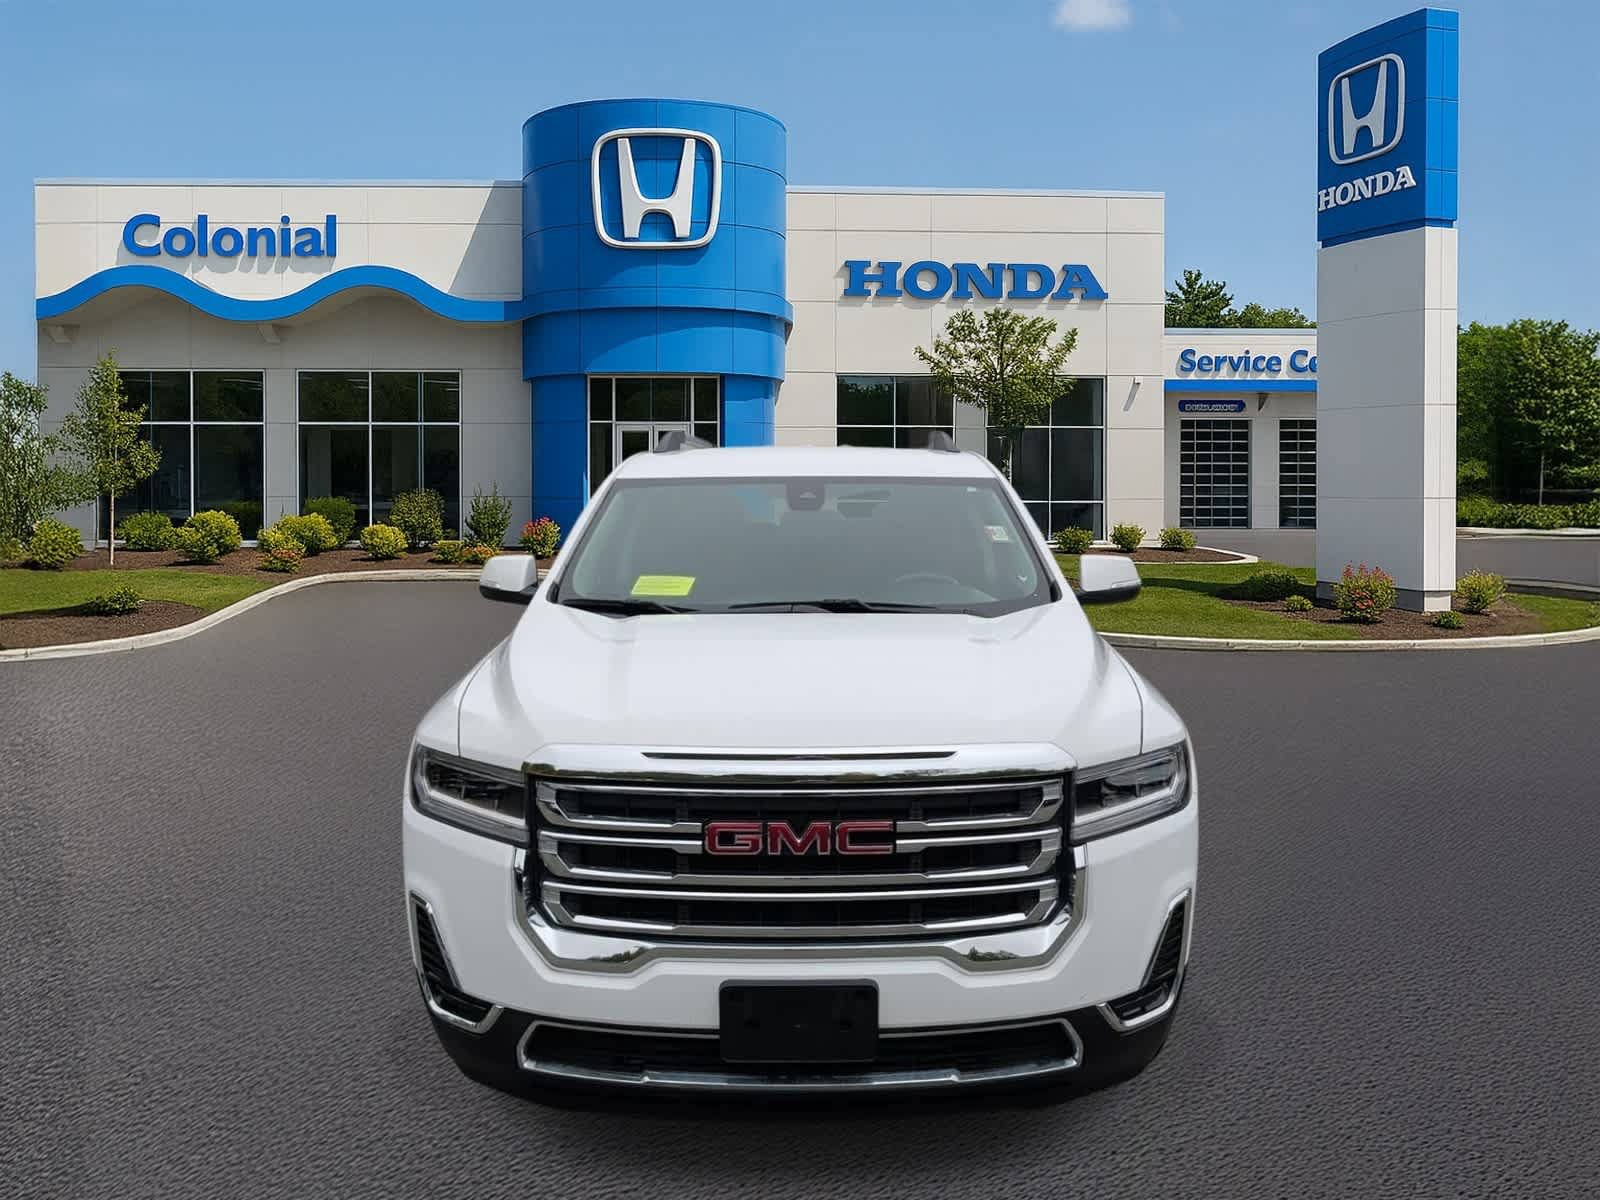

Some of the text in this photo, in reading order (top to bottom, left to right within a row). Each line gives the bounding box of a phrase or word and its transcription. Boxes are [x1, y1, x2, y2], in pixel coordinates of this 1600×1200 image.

[1318, 165, 1417, 212] HONDA
[122, 213, 337, 257] Colonial
[843, 260, 1109, 300] HONDA
[1180, 348, 1282, 373] Service
[704, 821, 894, 856] GMC
